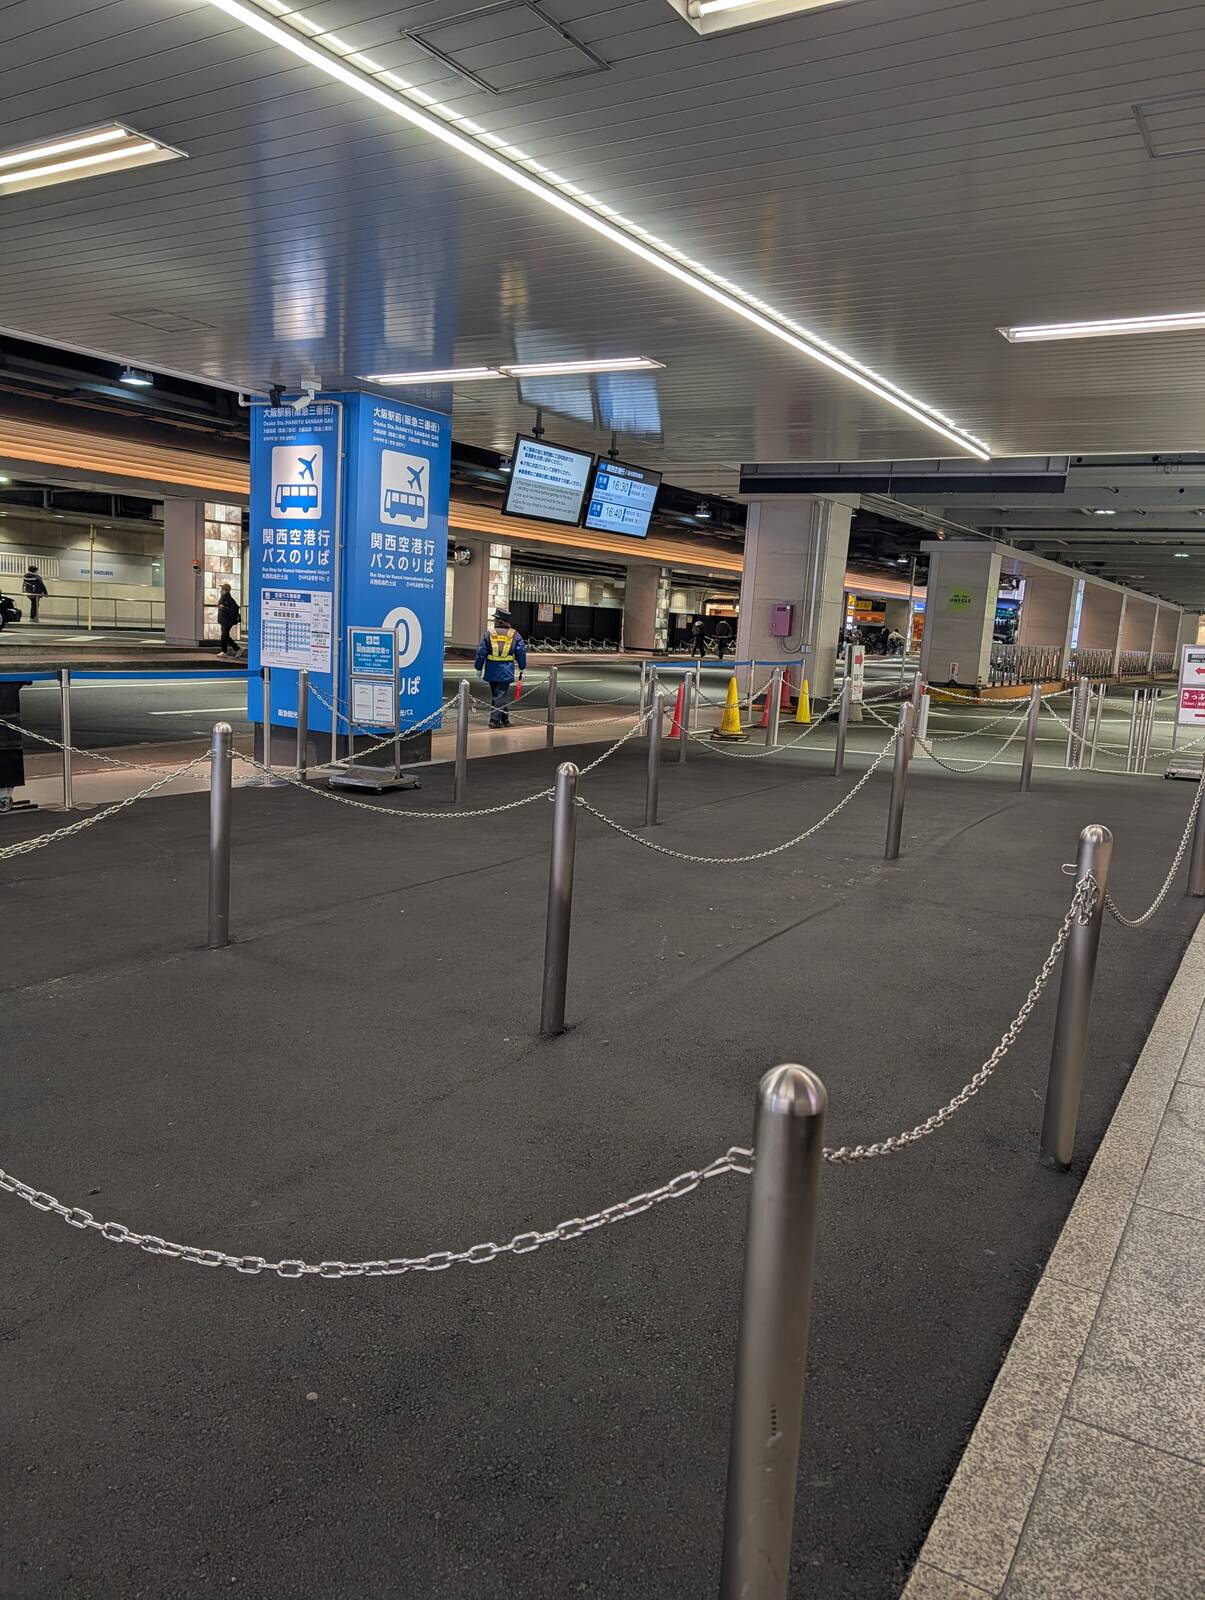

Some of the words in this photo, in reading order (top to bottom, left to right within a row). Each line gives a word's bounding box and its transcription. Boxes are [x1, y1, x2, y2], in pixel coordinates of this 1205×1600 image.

[373, 407, 440, 434] 大阪駅前(阪急三番街)
[612, 480, 629, 493] 16:30
[606, 506, 623, 519] 16:40
[262, 528, 330, 546] 関西空港行
[370, 532, 435, 556] 関西空港行
[262, 547, 331, 566] バスのりば
[370, 553, 435, 574] バスのりば
